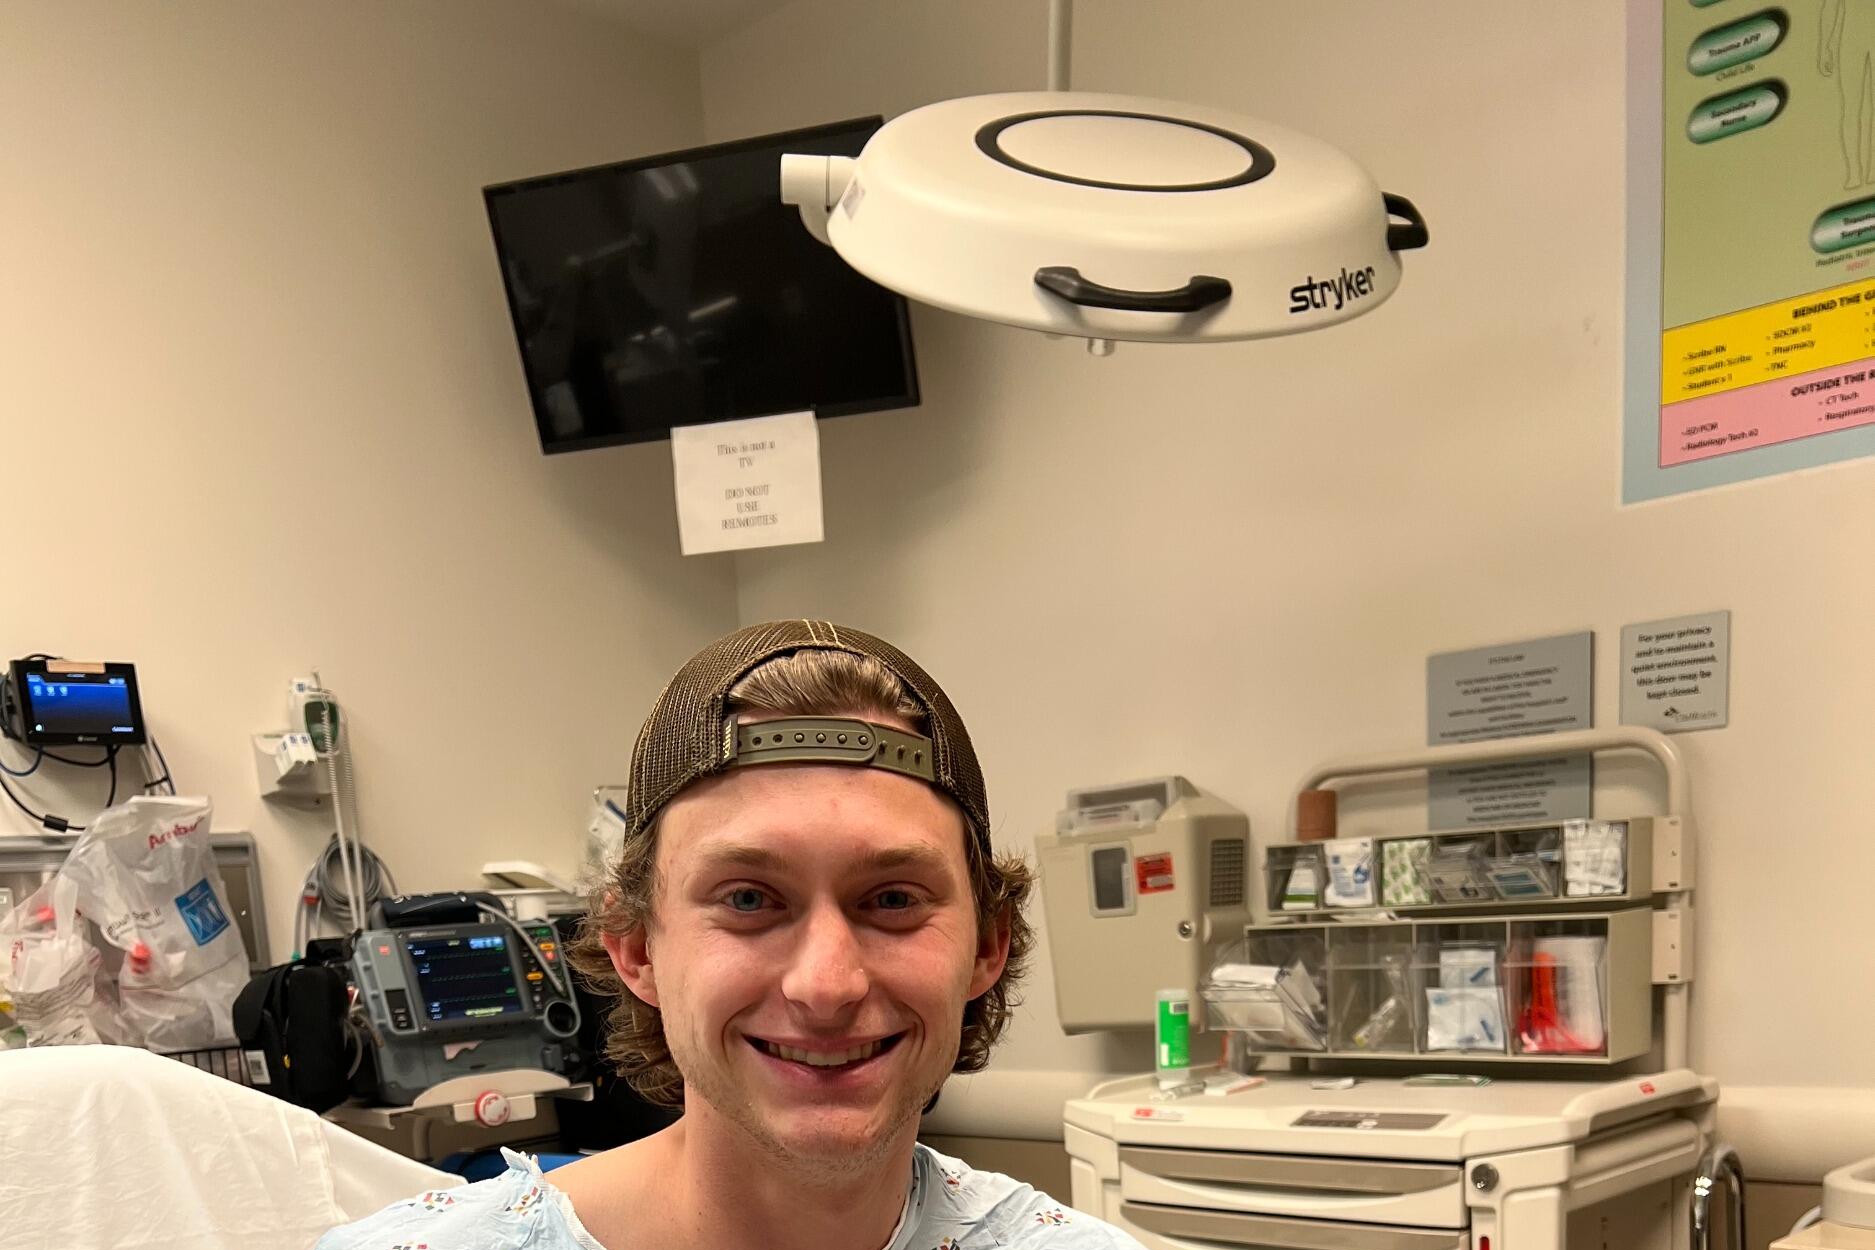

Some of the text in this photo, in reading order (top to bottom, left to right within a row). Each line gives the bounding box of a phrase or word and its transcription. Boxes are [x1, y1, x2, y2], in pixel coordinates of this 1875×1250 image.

[1290, 266, 1375, 313] stryker
[1792, 299, 1837, 319] BEHIND
[1838, 293, 1861, 307] THE
[1772, 339, 1816, 356] Pharmacy
[1791, 377, 1841, 397] OUTSIDE
[1844, 371, 1866, 385] THE
[1638, 625, 1712, 643] For your privacy
